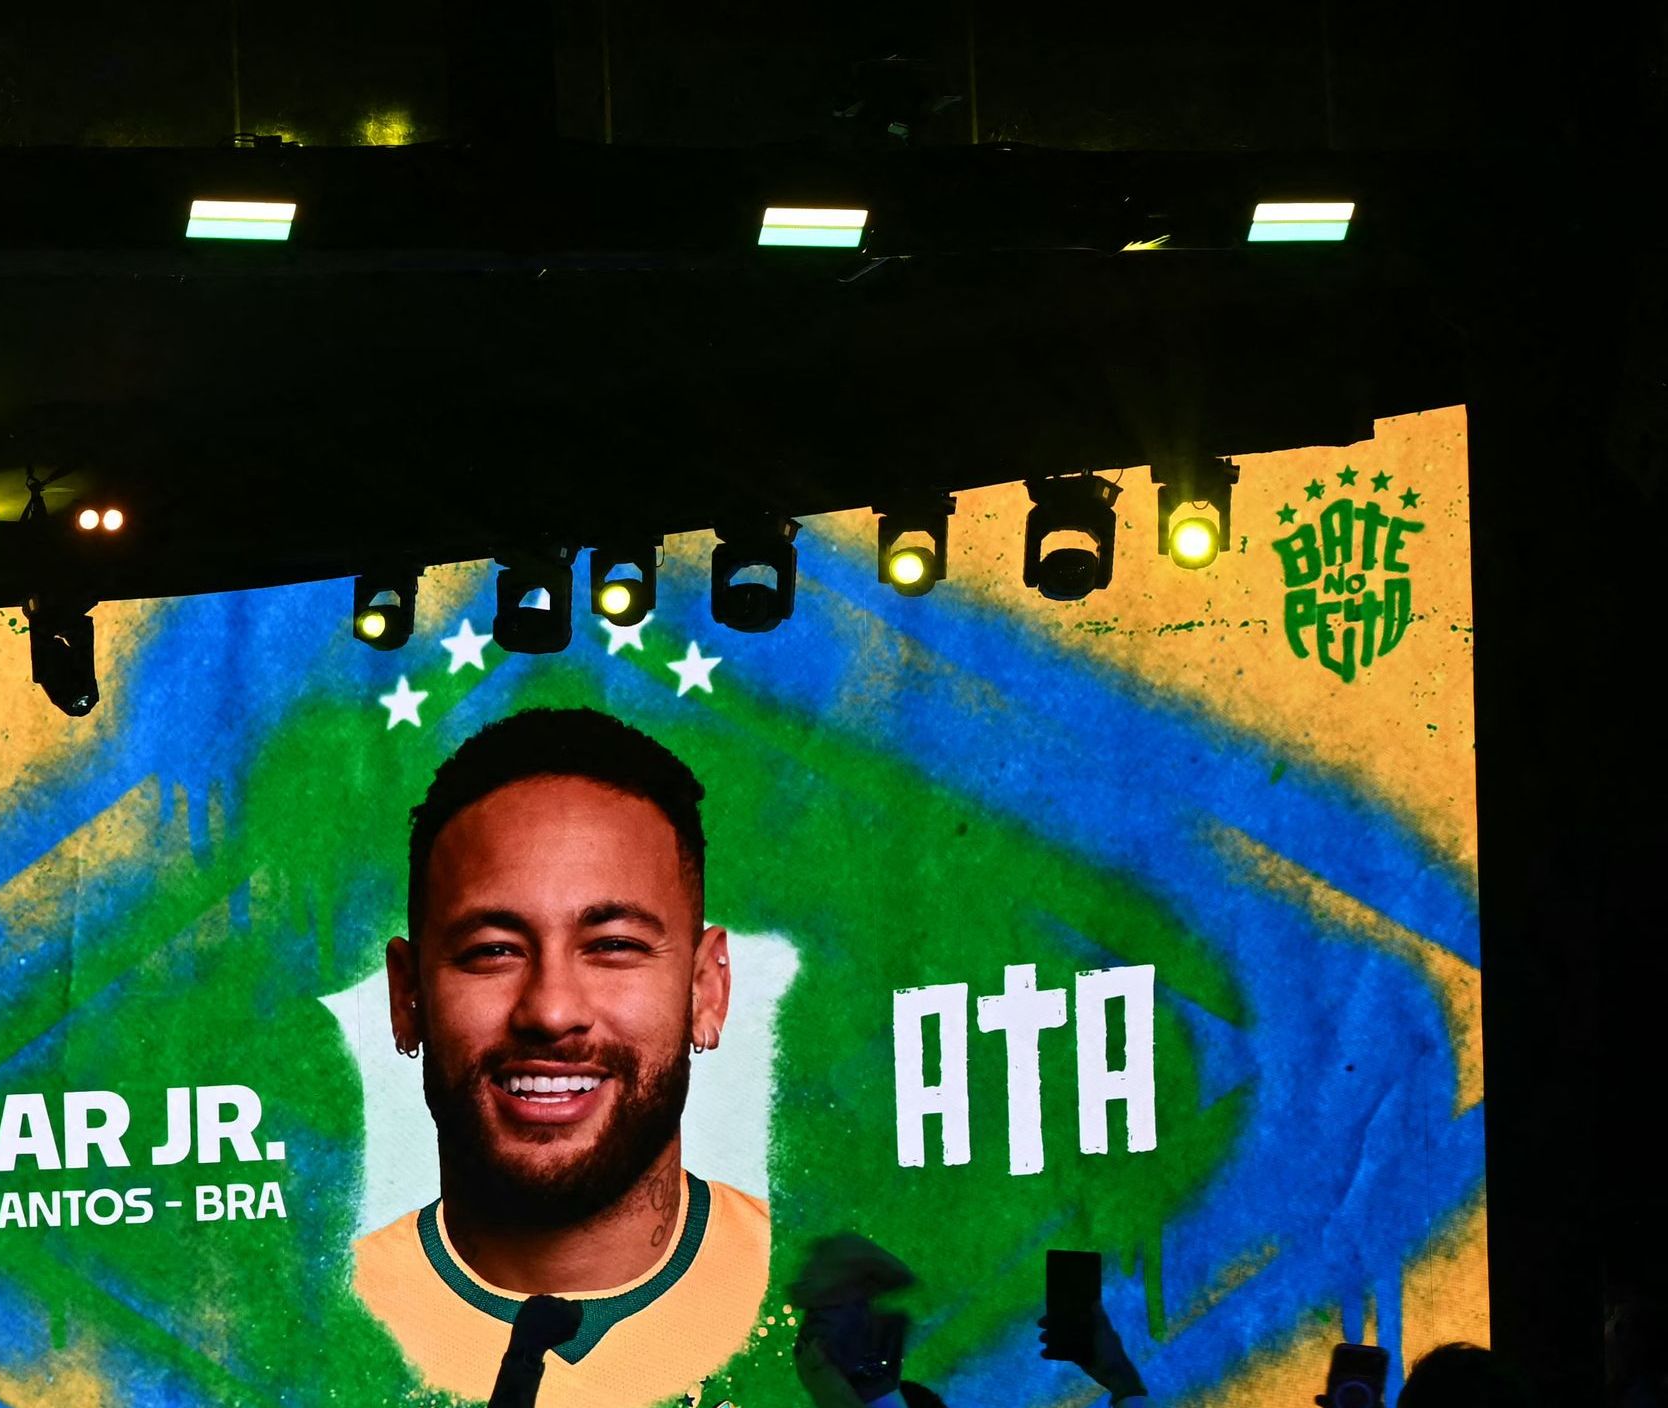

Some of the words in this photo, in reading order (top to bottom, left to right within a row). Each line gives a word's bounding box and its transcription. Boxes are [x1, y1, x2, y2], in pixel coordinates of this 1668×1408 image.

[1272, 498, 1425, 588] BATE
[1324, 566, 1366, 595] NO
[1284, 577, 1411, 684] PEITO
[893, 963, 1157, 1176] ATA
[151, 1084, 285, 1167] JR.
[194, 1181, 287, 1222] BRA
